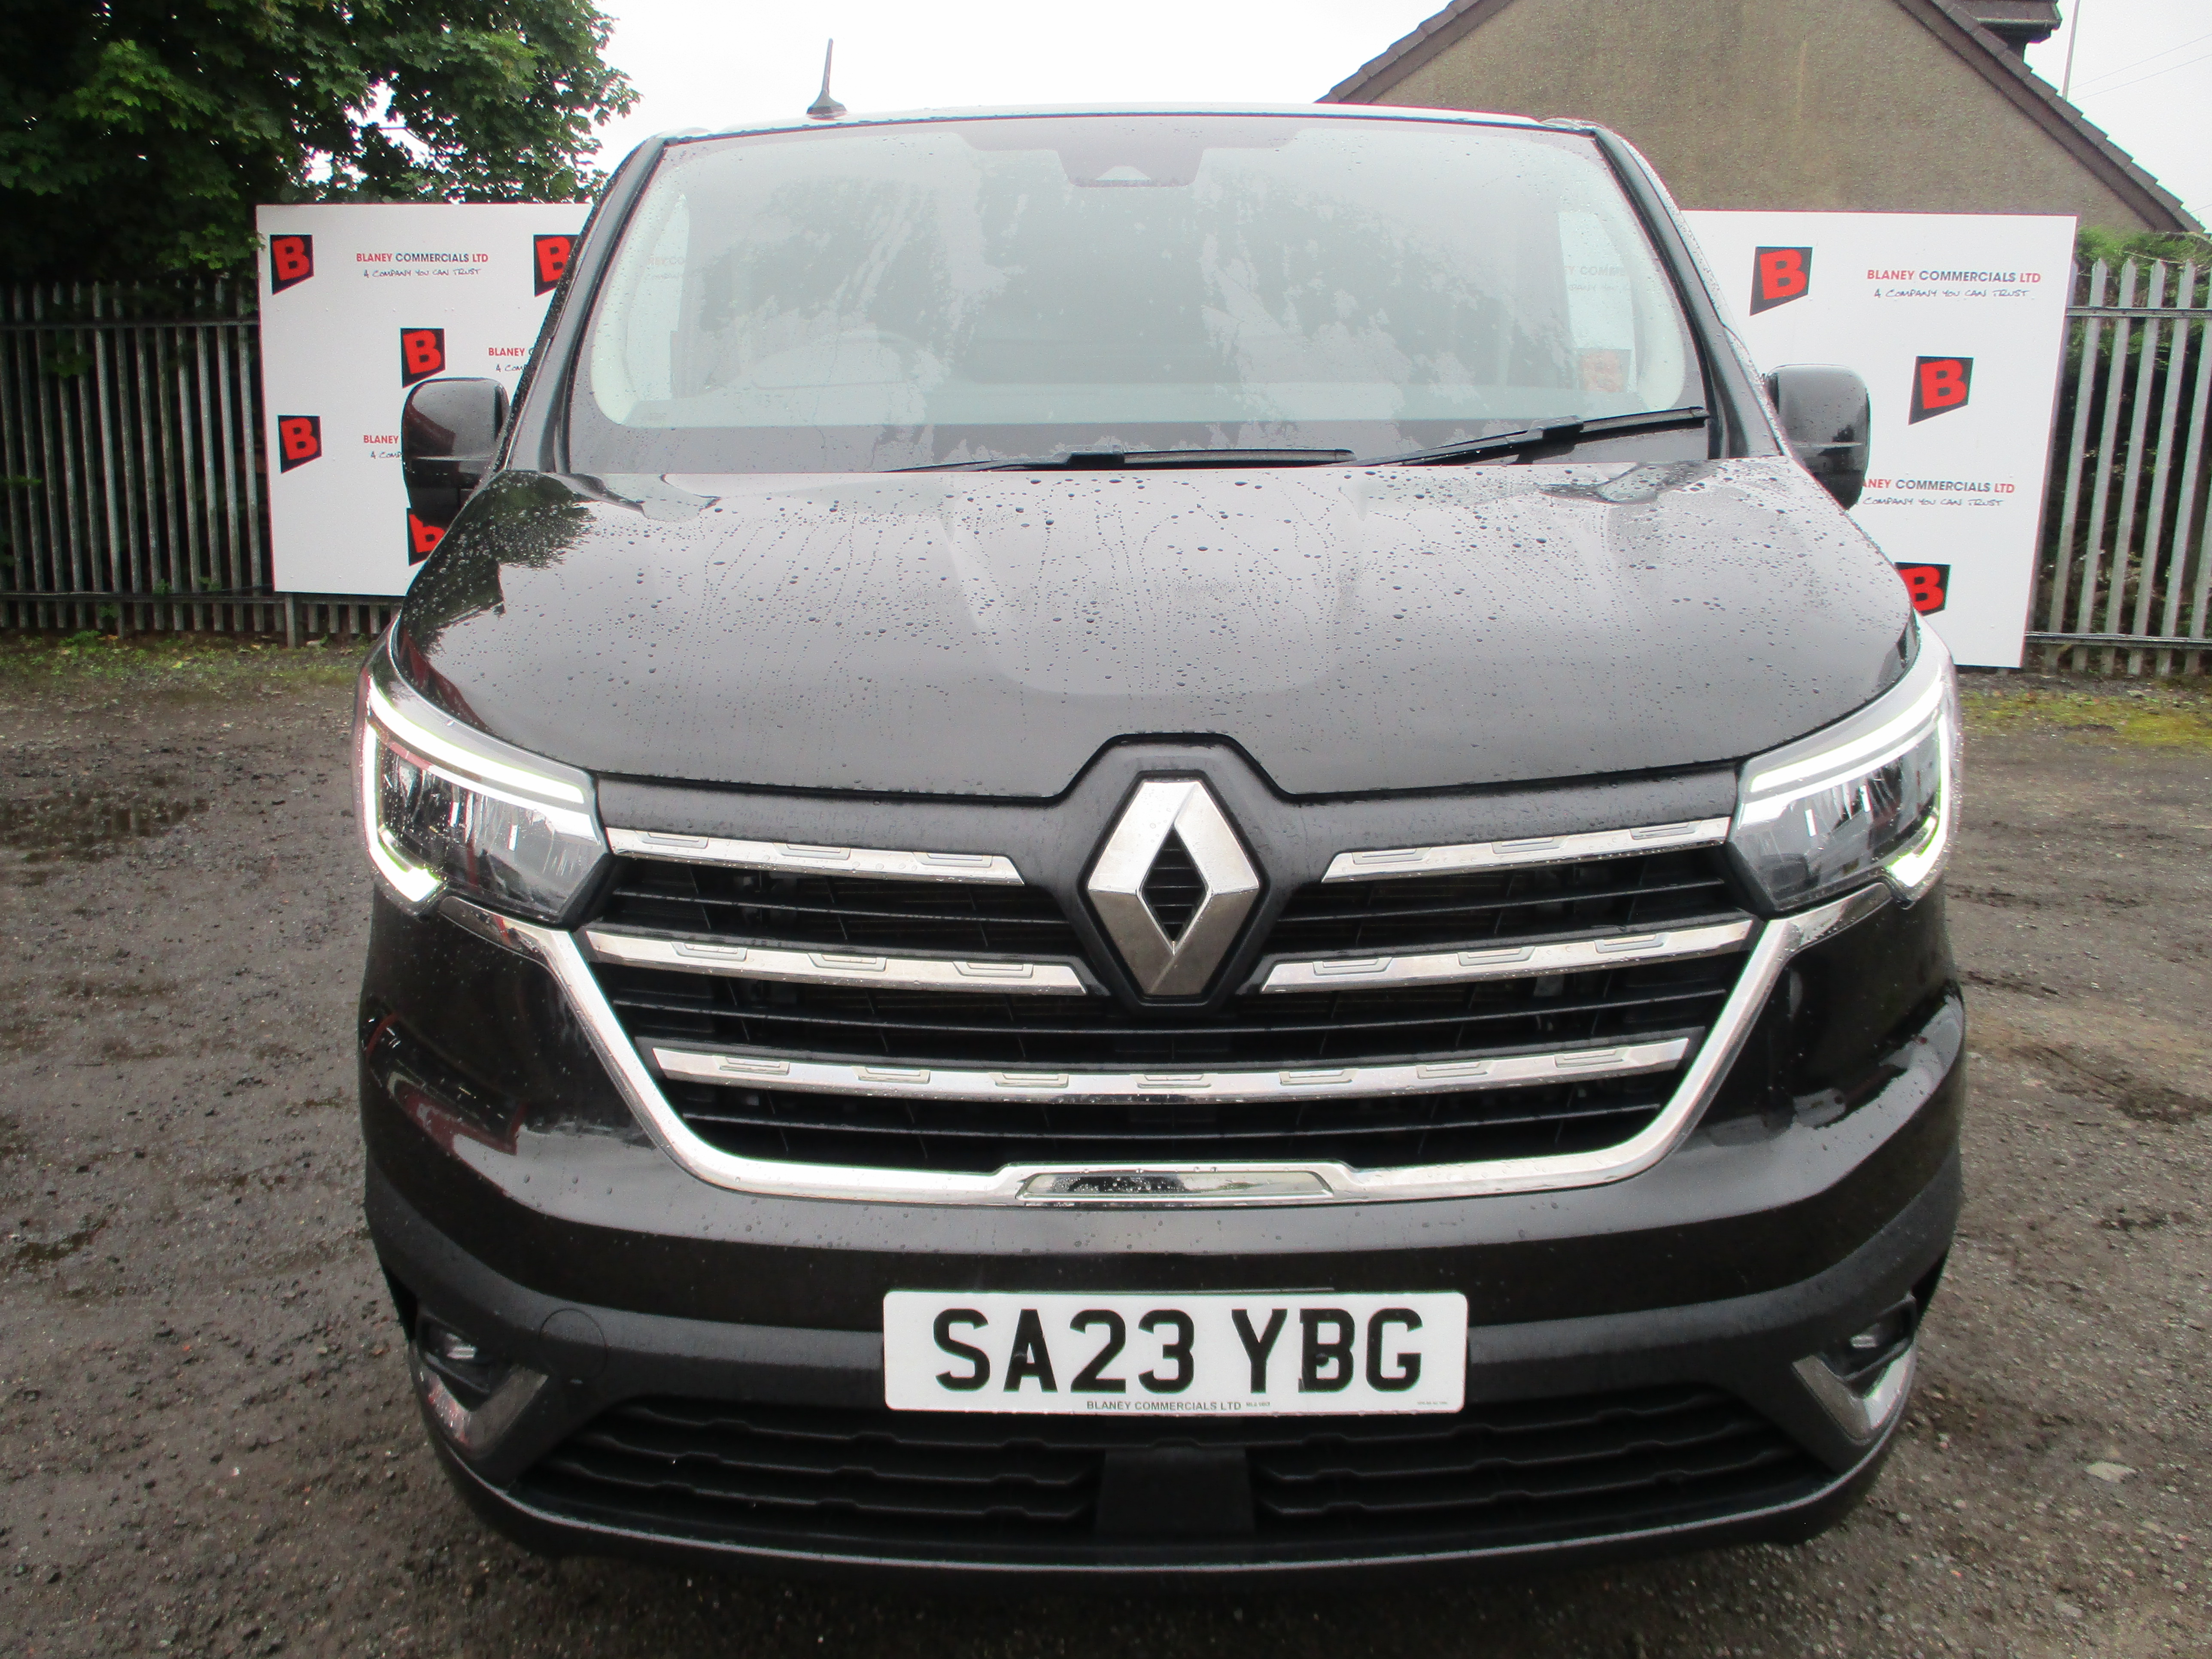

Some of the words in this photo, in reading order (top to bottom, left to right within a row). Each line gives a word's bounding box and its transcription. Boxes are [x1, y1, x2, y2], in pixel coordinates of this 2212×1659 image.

[273, 237, 310, 280] B
[356, 253, 392, 262] BLANEY
[395, 252, 469, 262] COMMERCIALS
[472, 253, 489, 262] LTD
[536, 236, 571, 282] B
[363, 269, 370, 278] A
[372, 269, 412, 278] COMPANY
[453, 267, 481, 276] TRUST
[1760, 249, 1807, 300] B
[1867, 269, 1915, 280] BLANEY
[1919, 270, 2017, 283] COMMERCIALS
[2019, 273, 2041, 283] LTD
[1874, 288, 1881, 298] A
[1885, 288, 1938, 298] COMPANY
[1942, 289, 1961, 297] YOU
[1964, 289, 1987, 297] CAN
[1992, 288, 2030, 298] TRUST
[403, 330, 441, 374] B
[488, 347, 526, 356] BLANEY
[1920, 359, 1967, 410] B
[281, 418, 318, 460] B
[363, 434, 399, 444] BLANEY
[379, 451, 402, 459] COMP
[1895, 479, 1992, 492] COMMERCIALS
[1993, 483, 2015, 493] LTD
[1863, 497, 1914, 505] COMPANY
[1940, 498, 1964, 506] CAN
[1967, 498, 2004, 507] TRUST
[1899, 566, 1944, 611] B
[933, 1308, 1195, 1394] SA23
[1231, 1307, 1423, 1394] YBG
[1087, 1401, 1131, 1410] BLANEY
[1135, 1401, 1217, 1411] COMMERCIALS
[1221, 1401, 1242, 1410] LTD
